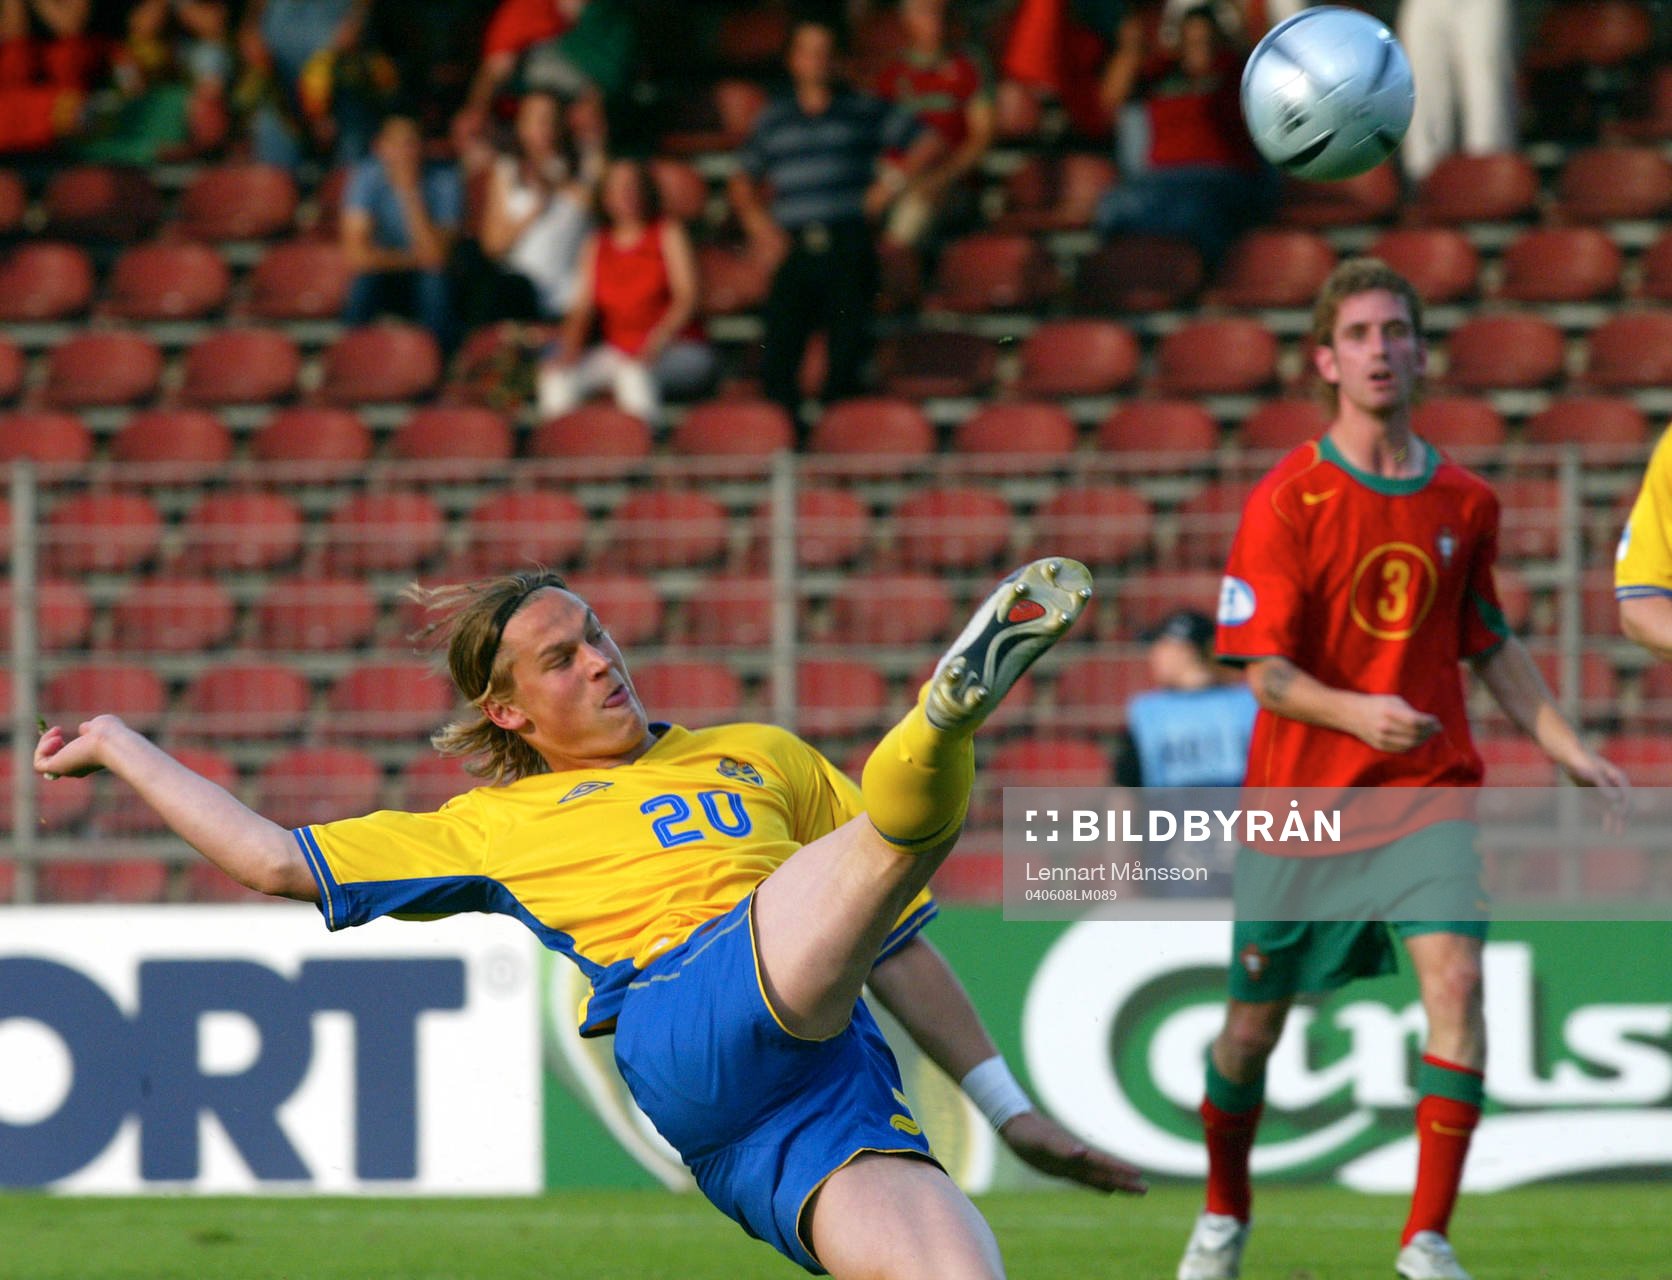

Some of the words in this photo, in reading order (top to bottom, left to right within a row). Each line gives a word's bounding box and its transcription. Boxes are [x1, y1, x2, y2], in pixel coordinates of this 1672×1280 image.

[1376, 560, 1411, 622] 3
[639, 789, 752, 849] 20
[0, 957, 467, 1185] ORT
